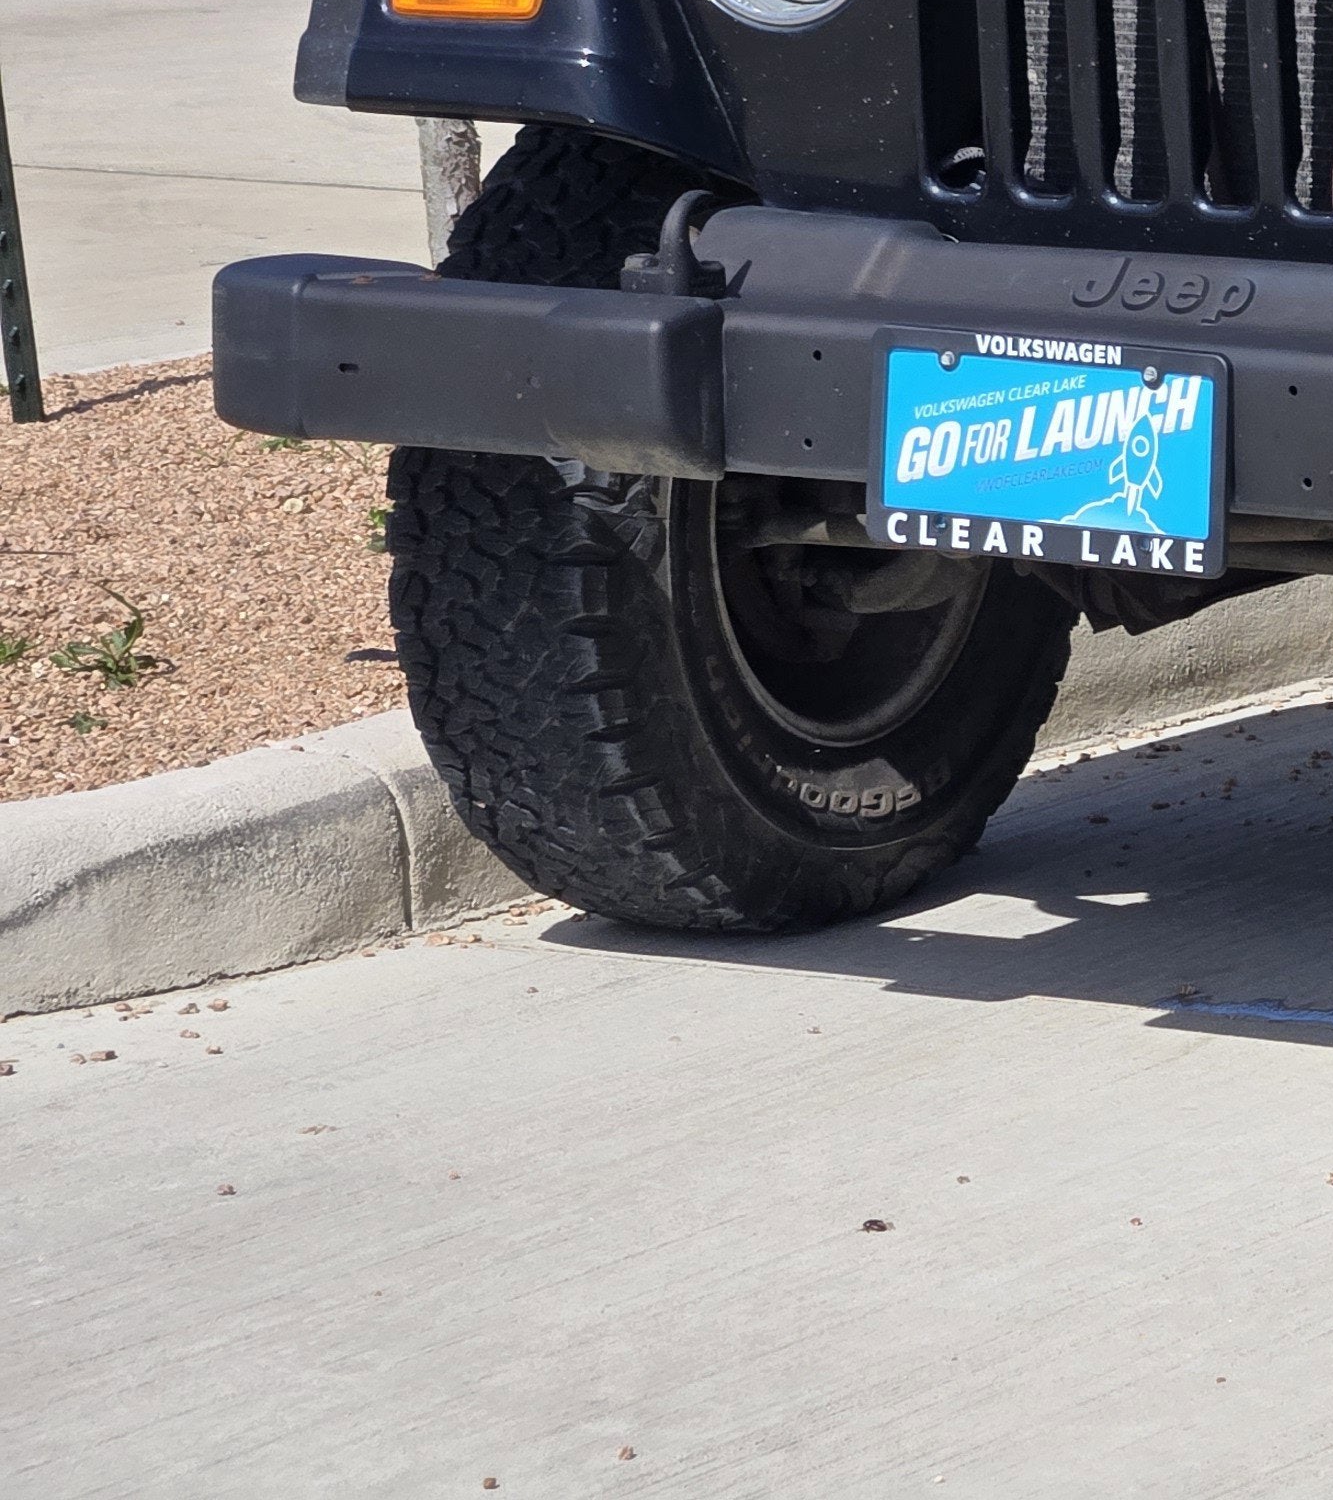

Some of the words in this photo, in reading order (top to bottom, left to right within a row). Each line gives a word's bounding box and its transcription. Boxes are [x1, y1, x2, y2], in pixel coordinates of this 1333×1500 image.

[1071, 257, 1256, 324] Jeep
[975, 334, 1122, 365] VOLKSWAGEN
[914, 391, 1005, 419] VOLKSWAGEN
[1008, 381, 1050, 403] CLEAR
[1053, 374, 1087, 393] LAKE
[897, 419, 961, 484] GO
[961, 417, 1012, 467] FOR
[1013, 375, 1202, 463] LAUNCH
[887, 512, 1044, 557] CLEAR
[1081, 530, 1205, 573] LAKE
